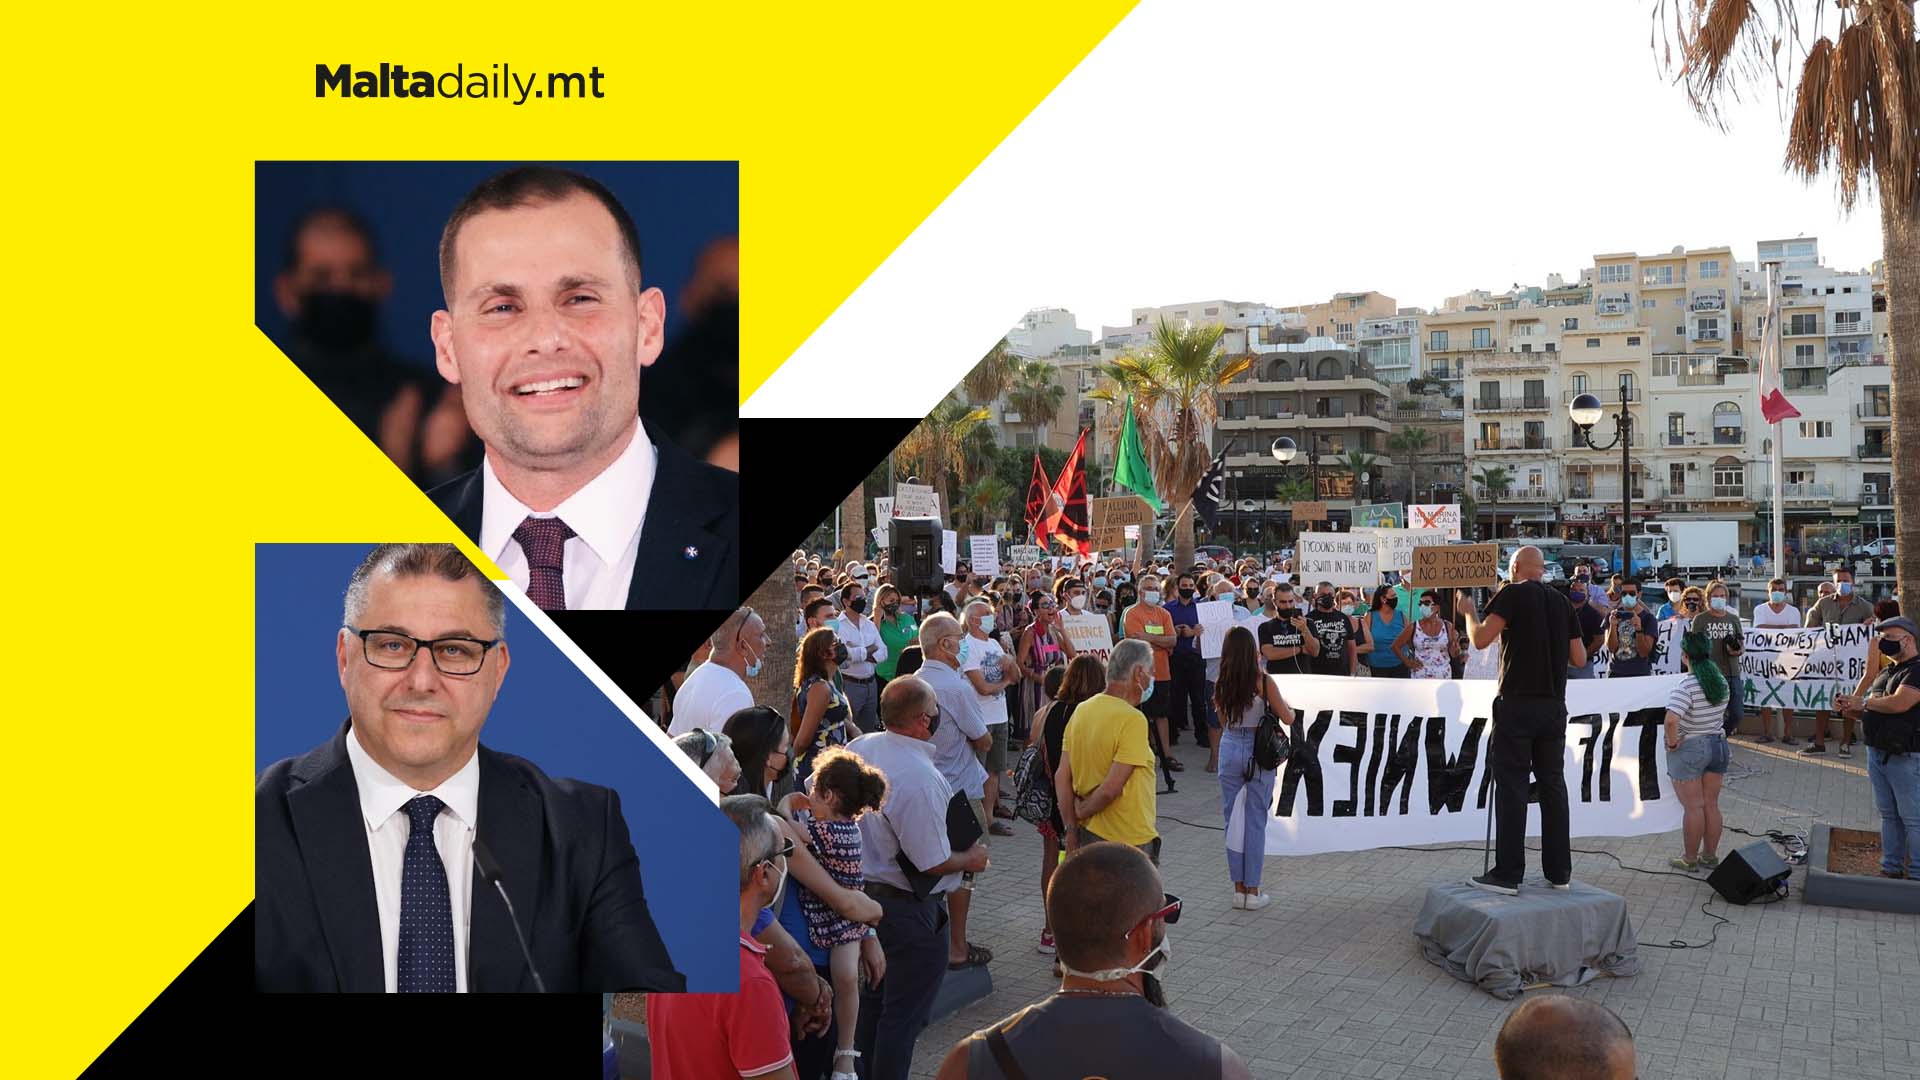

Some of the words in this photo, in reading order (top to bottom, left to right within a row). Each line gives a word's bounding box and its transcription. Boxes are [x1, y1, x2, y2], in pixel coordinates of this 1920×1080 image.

[1303, 540, 1335, 553] TYCOONS
[1337, 541, 1353, 554] HAVE
[1356, 542, 1377, 555] POOLS
[1392, 551, 1411, 567] PEO
[1420, 551, 1437, 566] NO
[1445, 550, 1493, 565] TYCOONS
[1301, 560, 1311, 573] WE
[1313, 560, 1332, 573] SWIM
[1334, 560, 1343, 573] IN
[1344, 560, 1357, 574] THE
[1358, 560, 1373, 574] BAY
[1420, 567, 1437, 581] NO
[1442, 564, 1497, 579] PONTOONS
[1744, 631, 1773, 648] TION
